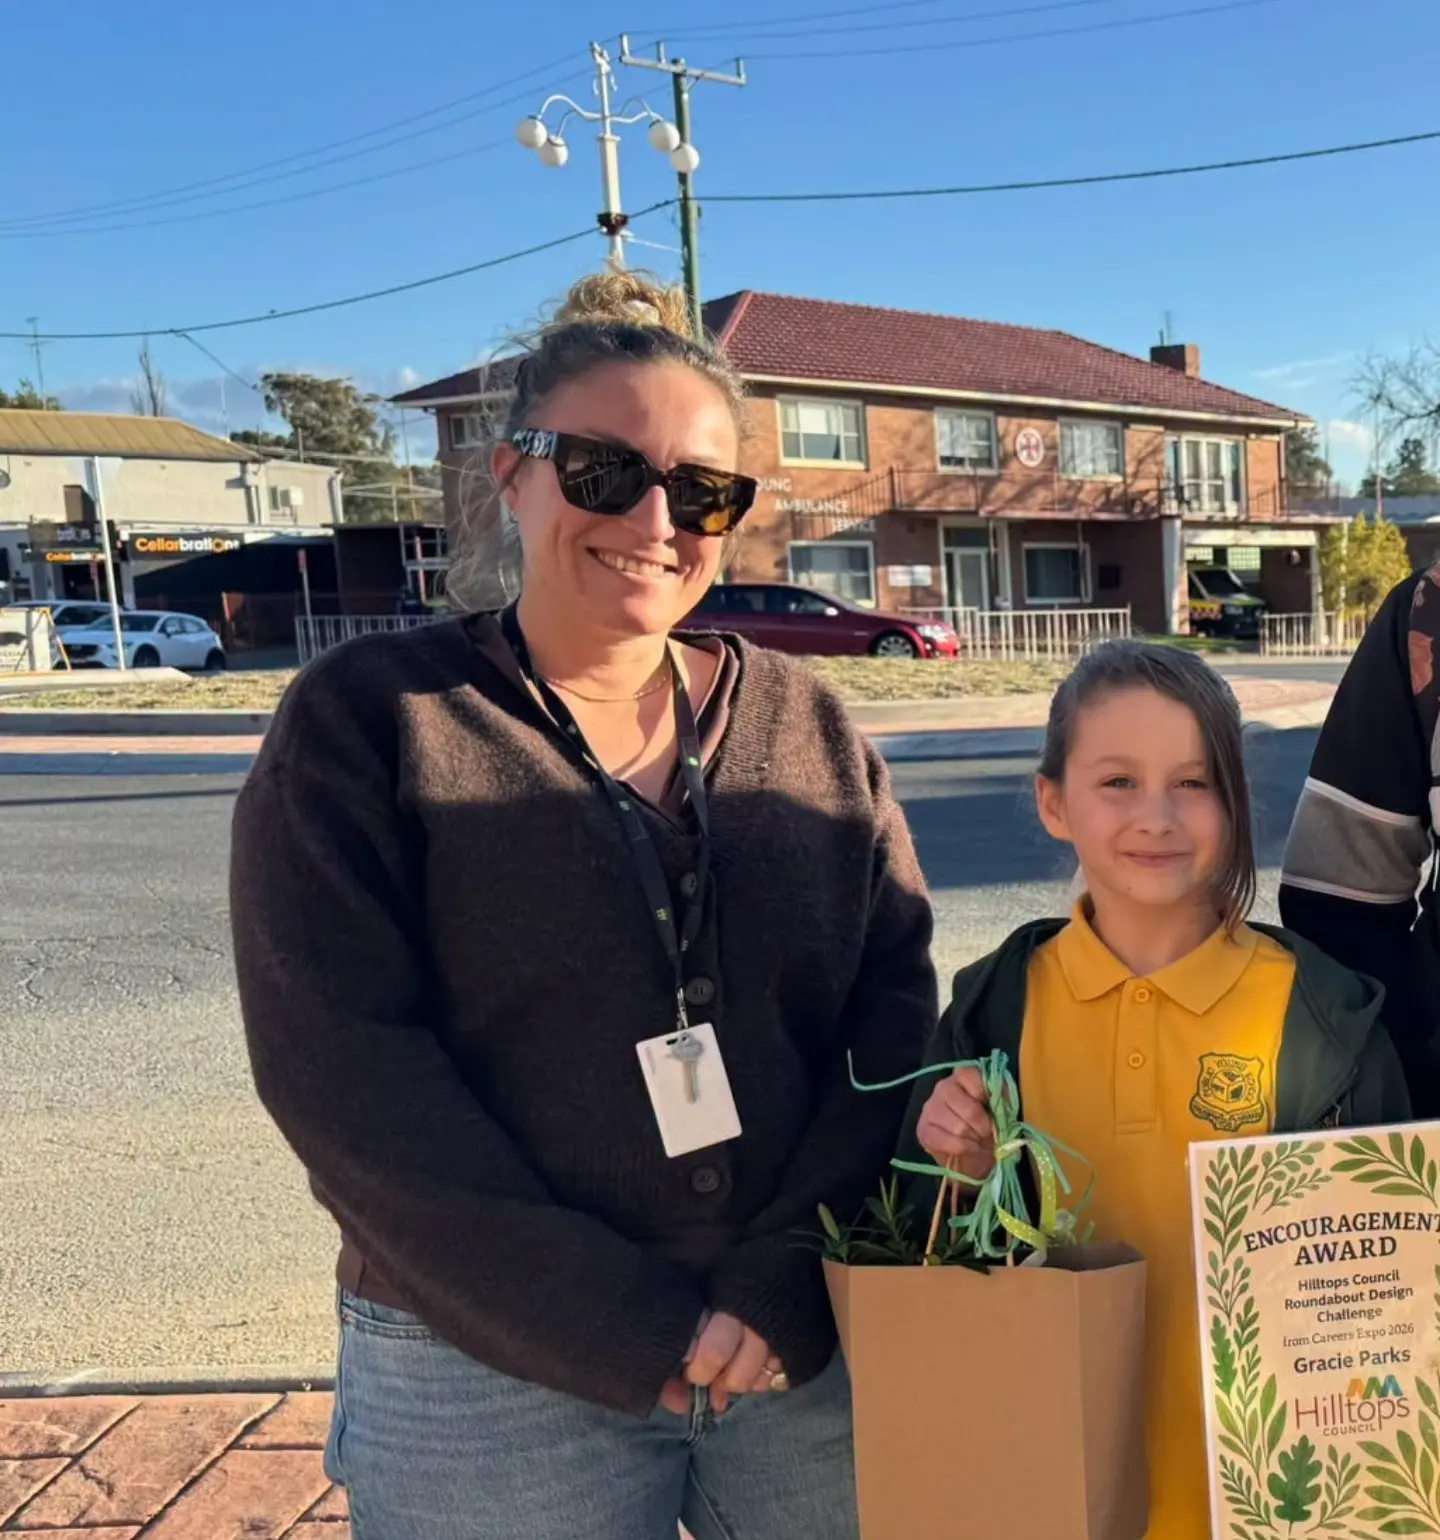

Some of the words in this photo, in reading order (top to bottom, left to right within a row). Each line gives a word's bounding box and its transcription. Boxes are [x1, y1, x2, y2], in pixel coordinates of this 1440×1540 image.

[756, 478, 792, 493] OUNG
[775, 498, 849, 513] AMBULANCE
[1294, 1235, 1398, 1267] AWARD
[1298, 1276, 1349, 1292] Hilltops
[1352, 1269, 1400, 1286] Council
[1284, 1290, 1365, 1310] Roundabout
[1368, 1285, 1414, 1301] Design
[1317, 1306, 1384, 1323] Challenge
[1283, 1335, 1310, 1347] from
[1311, 1331, 1354, 1345] Careers
[1356, 1327, 1386, 1341] Expo
[1387, 1322, 1415, 1336] 2026
[1293, 1352, 1354, 1374] Gracie
[1359, 1345, 1412, 1367] Parks
[1294, 1392, 1411, 1431] Hilltops
[1322, 1423, 1377, 1437] COUNCIL
